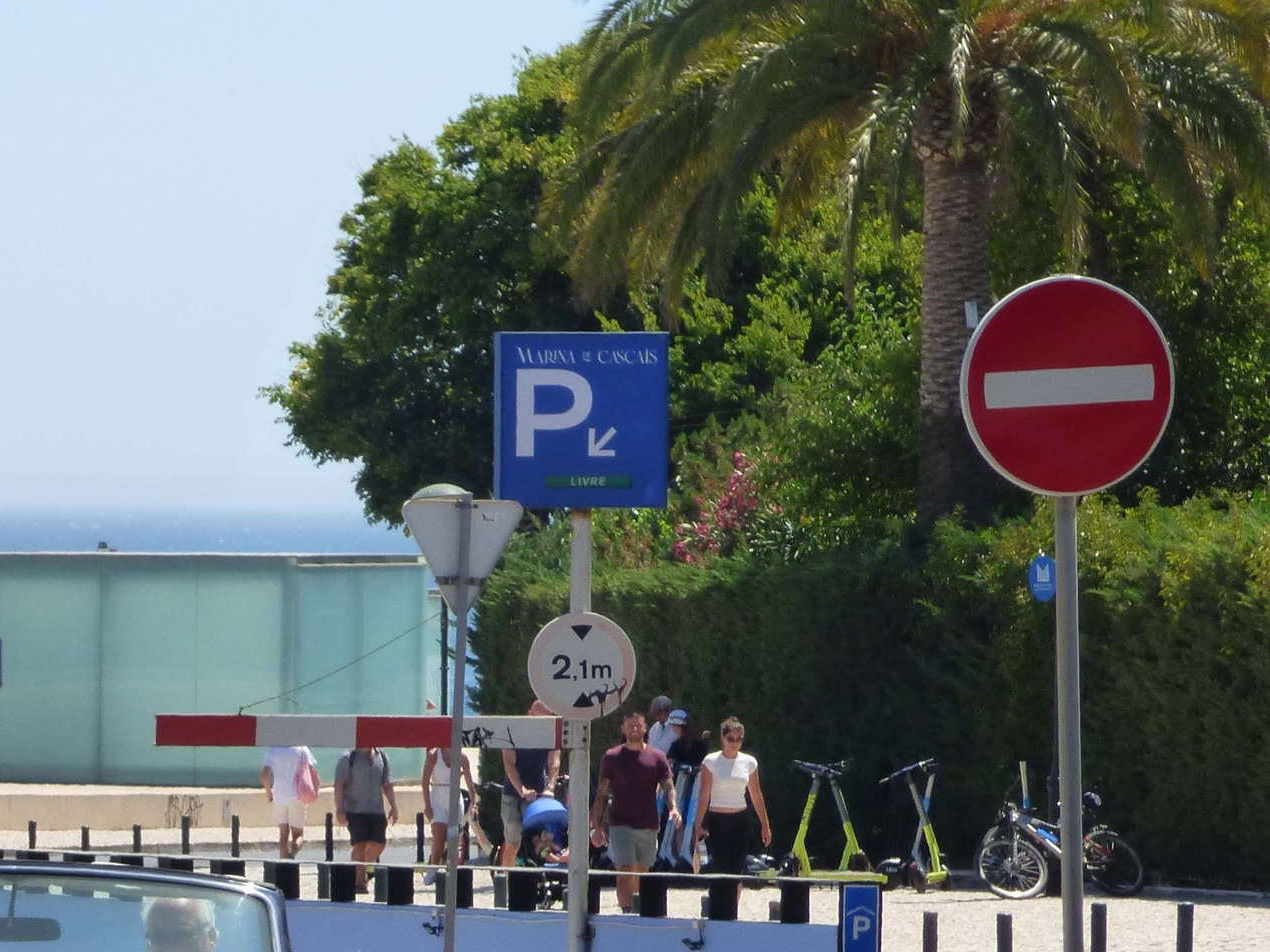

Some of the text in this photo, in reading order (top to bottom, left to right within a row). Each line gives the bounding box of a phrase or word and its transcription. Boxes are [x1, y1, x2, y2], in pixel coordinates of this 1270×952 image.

[517, 347, 576, 364] MARINA
[597, 348, 658, 364] CASCAIS
[516, 368, 593, 457] P
[570, 477, 607, 486] LIVRE
[552, 654, 612, 681] 2,1m
[852, 915, 871, 941] P
